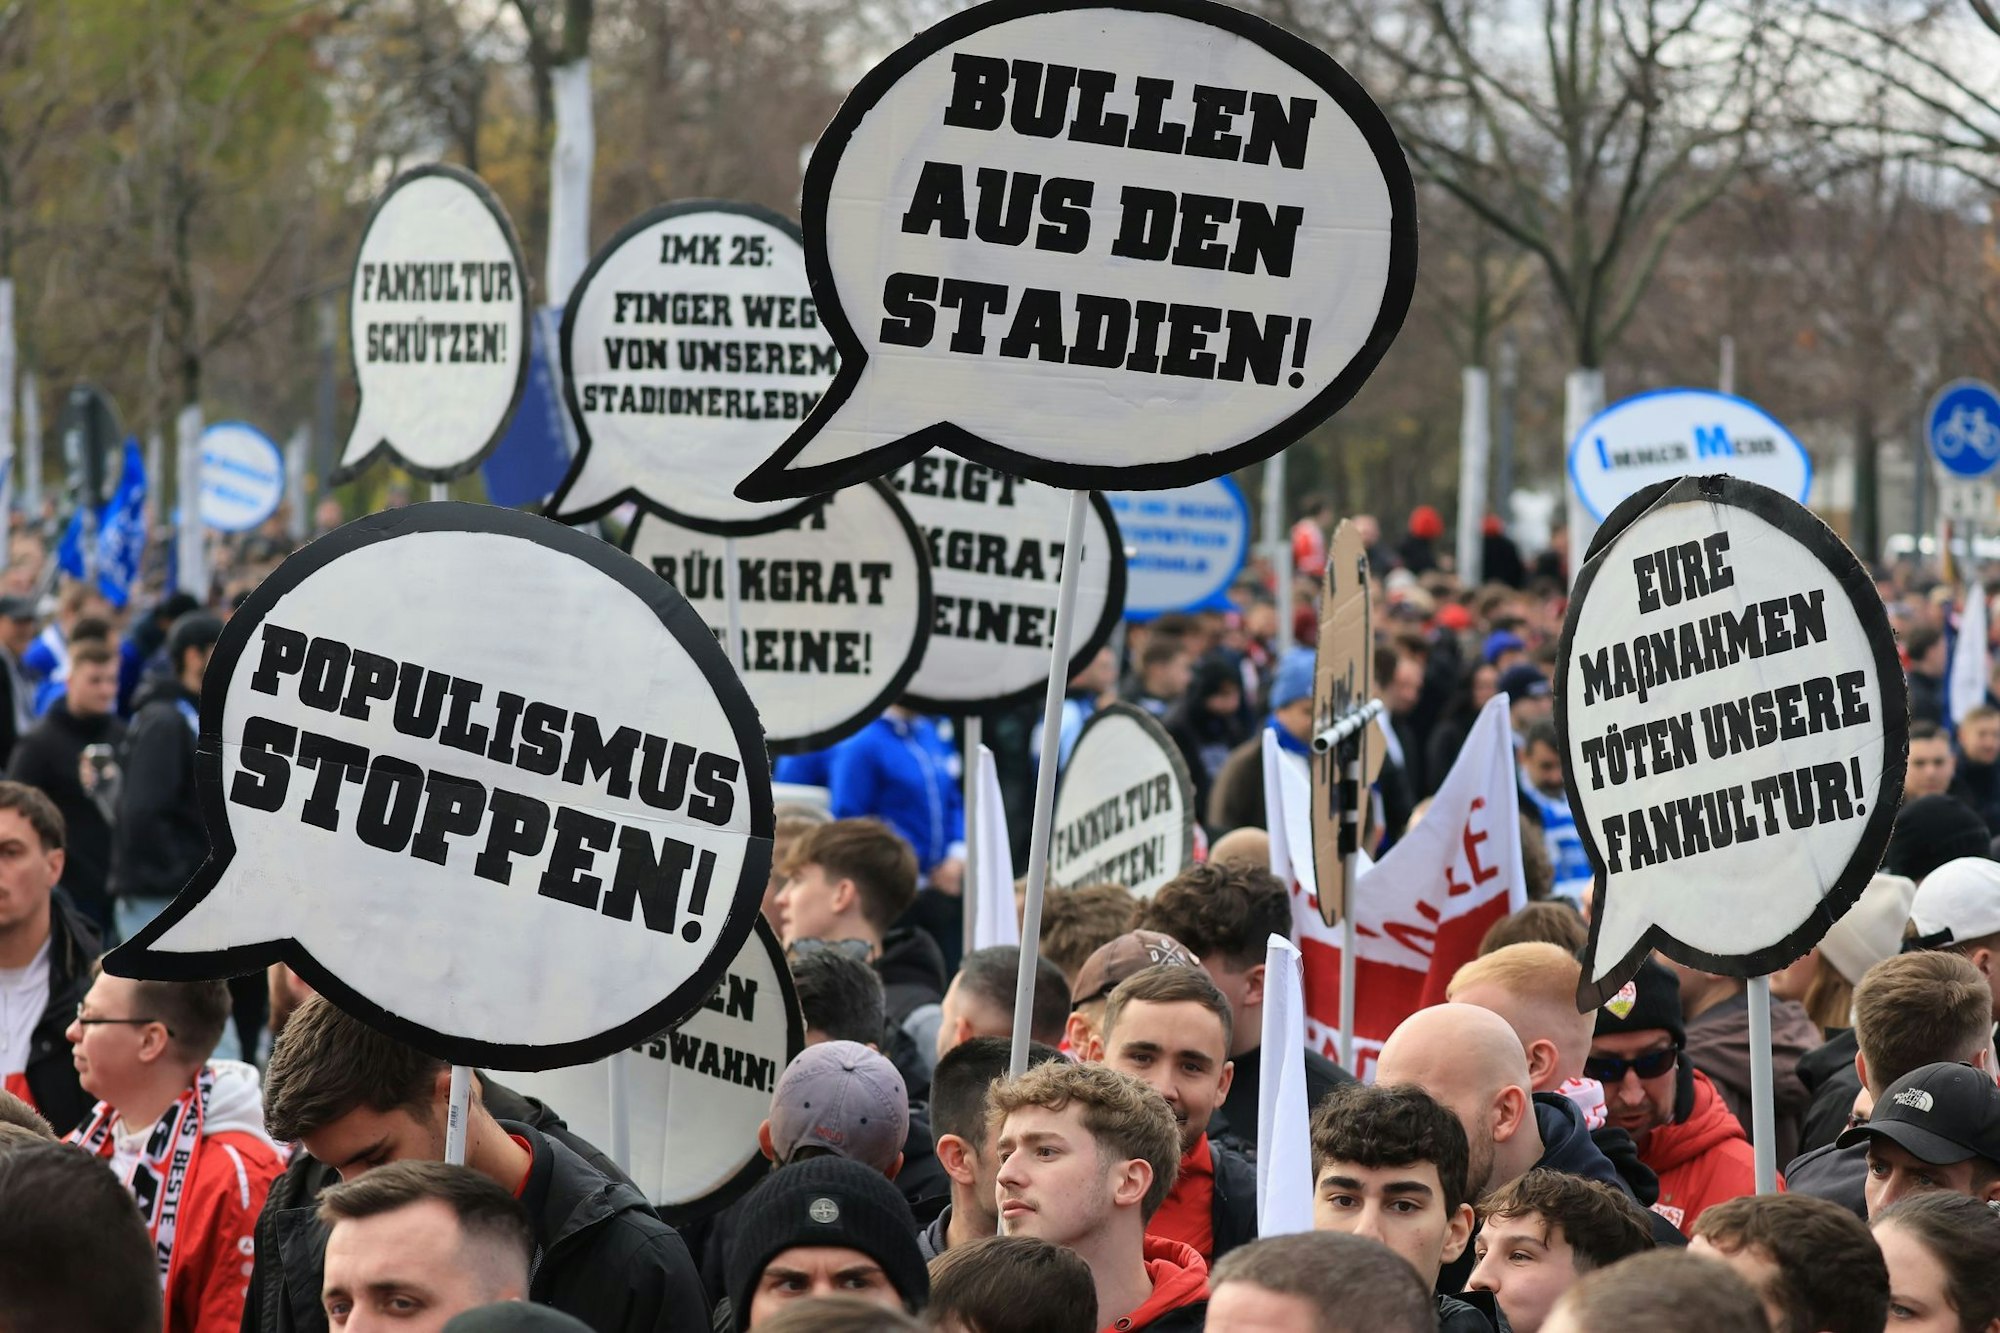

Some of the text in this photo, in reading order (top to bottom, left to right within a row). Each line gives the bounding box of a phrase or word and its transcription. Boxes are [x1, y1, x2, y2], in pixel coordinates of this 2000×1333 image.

[943, 52, 1317, 170] BULLEN
[660, 234, 773, 267] IMK 25:
[901, 160, 1304, 278] AUS DEN
[363, 262, 512, 302] FANKULTUR
[614, 292, 817, 329] FINGER WEG
[367, 316, 506, 363] SCHÜTZEN!
[604, 338, 838, 375] VON UNSEREM
[879, 272, 1312, 389] STADIEN!
[1633, 531, 1734, 614] EURE
[250, 623, 740, 826] POPULISMUS
[1581, 670, 1870, 791] TÖTEN UNSERE
[230, 715, 717, 943] STOPPEN!
[1056, 772, 1172, 871] FANKULTUR
[1602, 756, 1866, 874] FANKULTUR!
[1907, 1087, 1924, 1097] THE
[160, 1150, 191, 1226] BESTE
